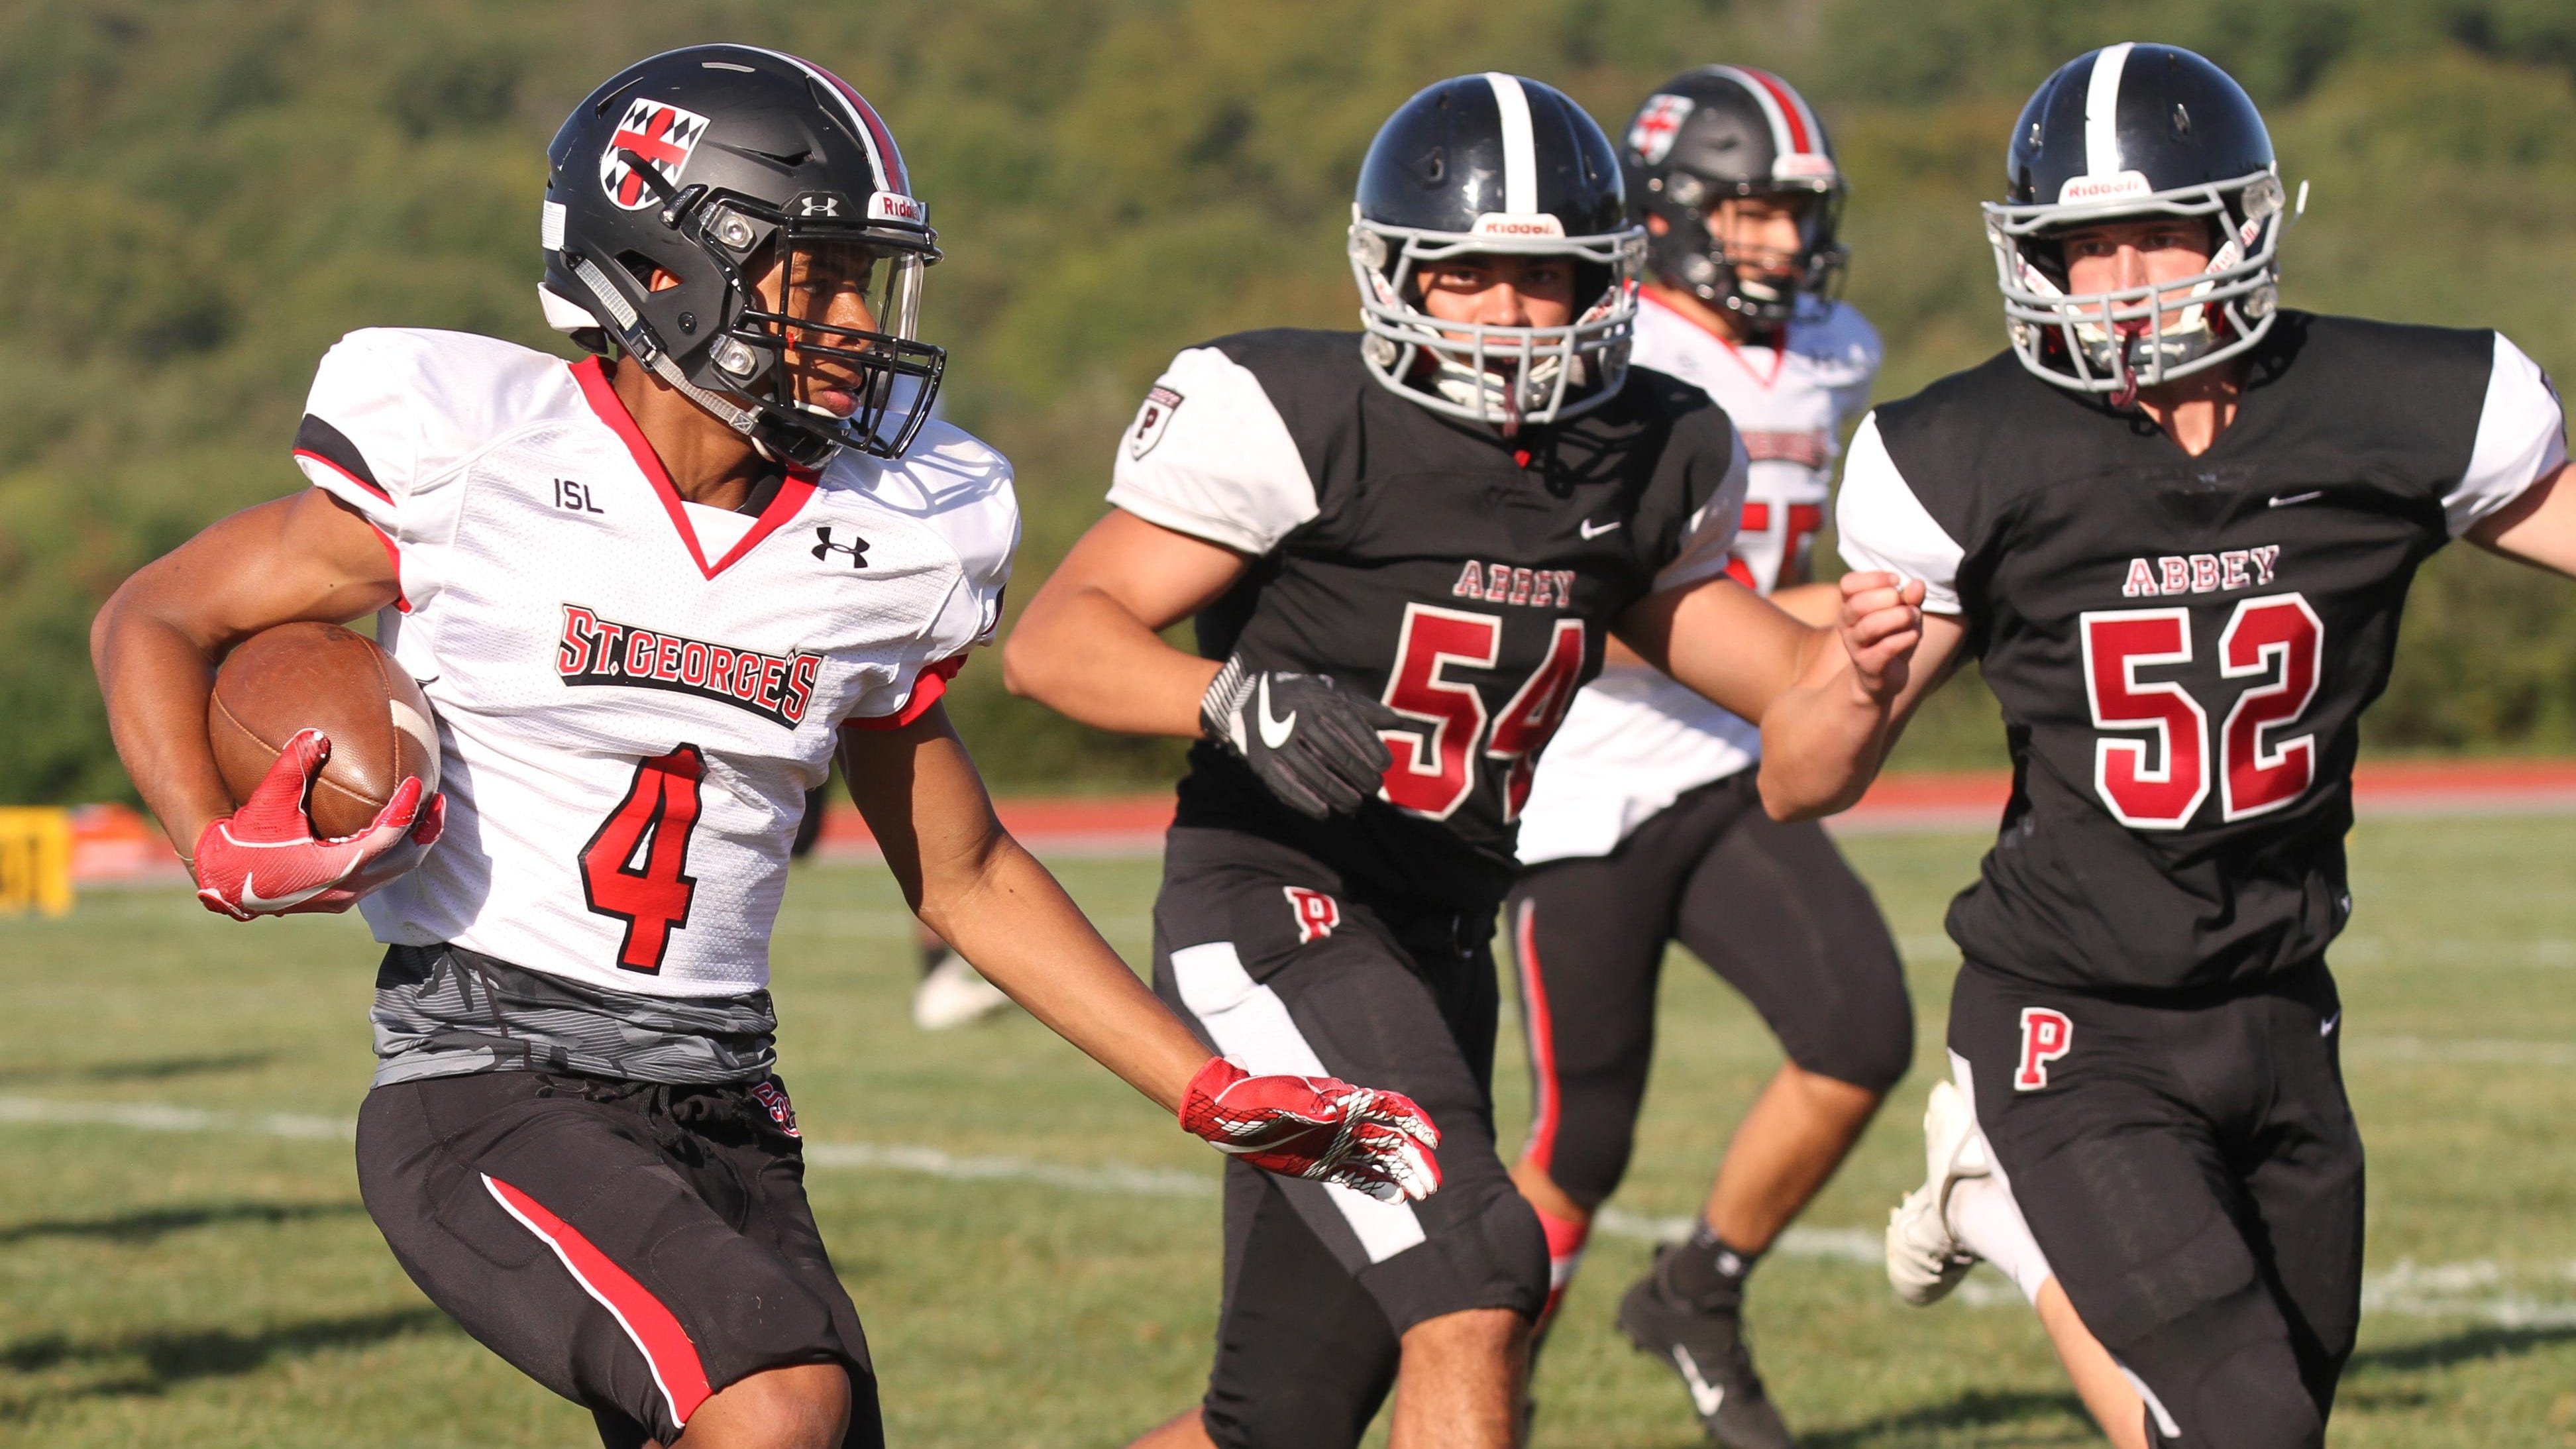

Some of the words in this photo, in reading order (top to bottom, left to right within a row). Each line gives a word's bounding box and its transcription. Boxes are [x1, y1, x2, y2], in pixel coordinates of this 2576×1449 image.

[1136, 407, 1158, 439] P
[554, 478, 604, 514] ISL
[1452, 559, 1576, 608] ABBEY
[2122, 545, 2280, 597] ABBEY
[1377, 601, 1585, 826] 54
[2080, 592, 2324, 830] 52
[578, 741, 710, 976] 4
[1283, 885, 1340, 944] P
[2013, 1006, 2073, 1091] P
